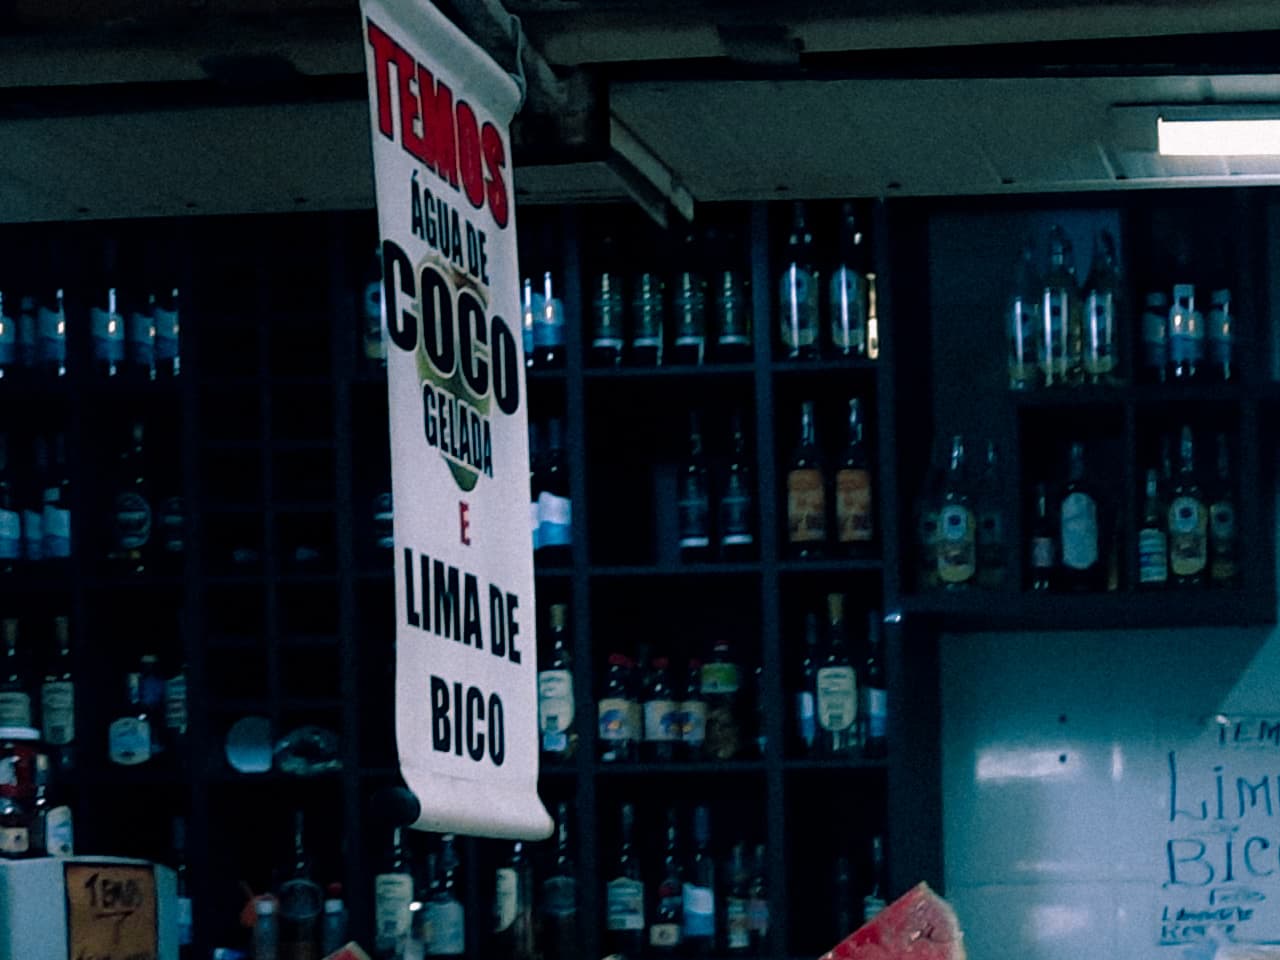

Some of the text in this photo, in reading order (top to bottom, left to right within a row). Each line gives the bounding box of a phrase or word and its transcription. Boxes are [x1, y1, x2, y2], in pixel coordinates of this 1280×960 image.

[367, 16, 508, 229] TEMOS
[411, 170, 490, 286] ÁGUA DE
[383, 239, 519, 414] COCO
[423, 384, 493, 478] GELADA
[459, 500, 471, 546] E
[404, 547, 521, 664] LIMA DE
[430, 675, 505, 766] BICO
